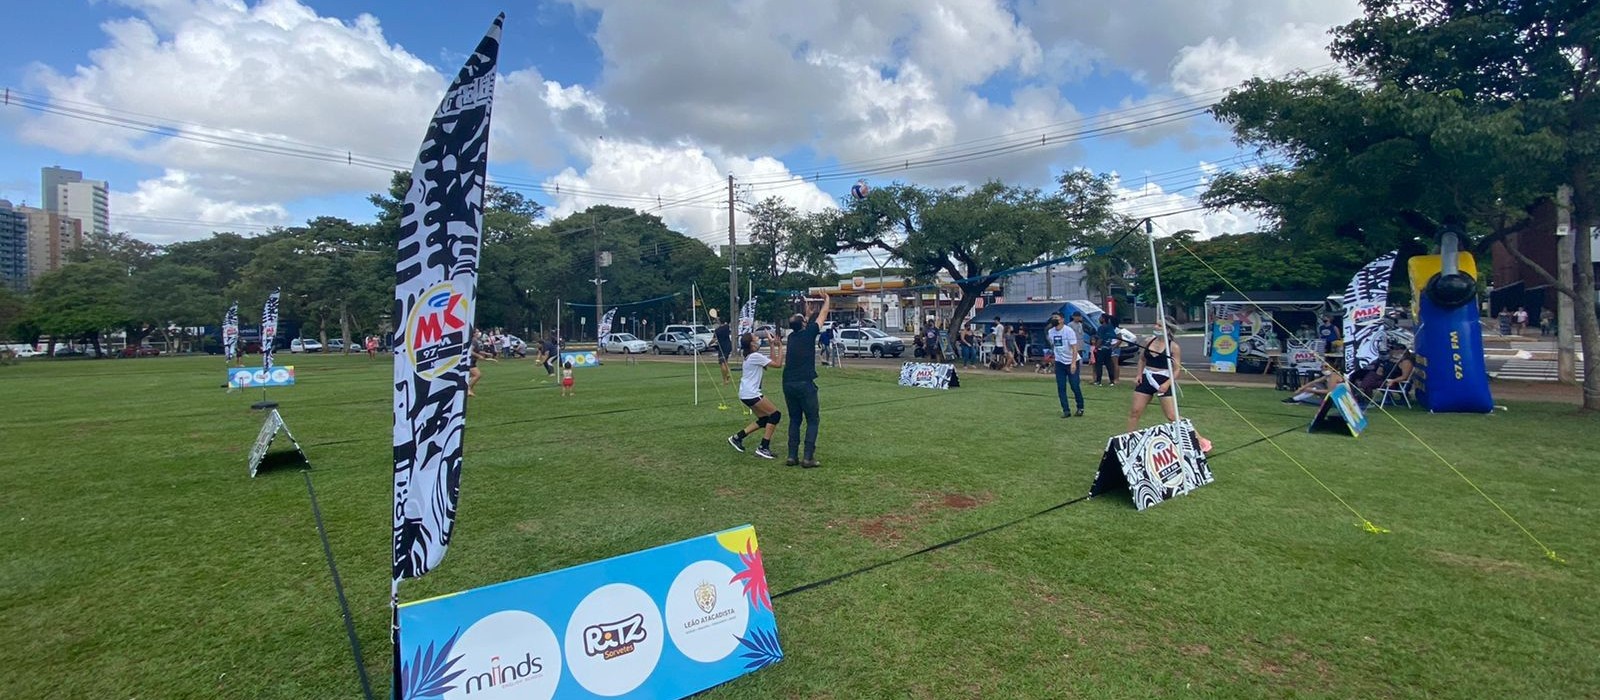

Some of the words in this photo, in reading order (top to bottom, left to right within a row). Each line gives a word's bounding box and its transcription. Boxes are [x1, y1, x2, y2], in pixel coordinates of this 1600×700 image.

[1354, 306, 1381, 319] MIX
[1449, 331, 1460, 350] FM
[1294, 352, 1316, 360] MIX
[1452, 353, 1464, 380] 97.9
[1153, 443, 1178, 472] MIX
[684, 618, 700, 629] LEÃO
[700, 608, 735, 623] ATACADISTA
[604, 645, 634, 658] Sorvetes
[465, 652, 543, 695] minds
